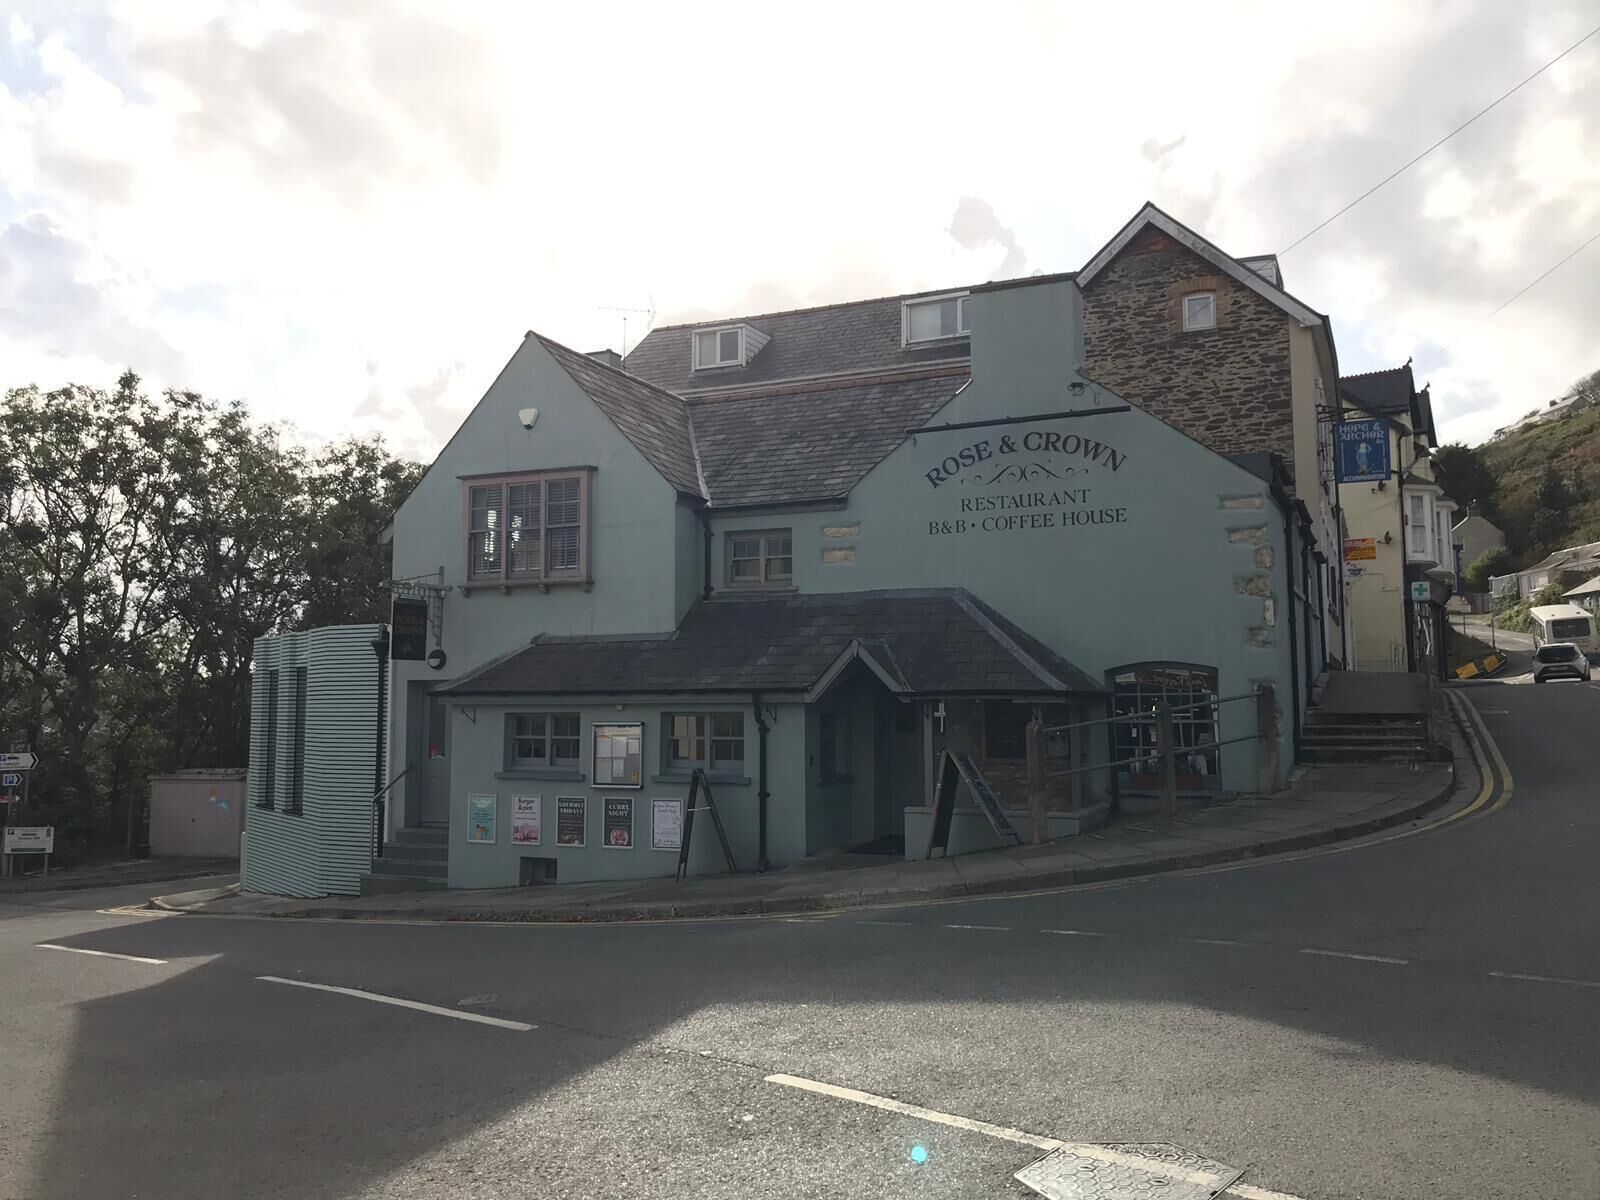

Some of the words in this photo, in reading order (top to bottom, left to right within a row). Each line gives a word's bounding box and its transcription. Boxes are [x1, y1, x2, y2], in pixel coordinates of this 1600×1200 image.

[1339, 423, 1369, 433] HOPE
[1373, 422, 1381, 431] &
[1340, 430, 1385, 441] ANCHOR
[924, 440, 993, 489] ROSE
[998, 435, 1018, 455] &
[1023, 431, 1128, 473] CROWN
[960, 488, 1092, 512] RESTAURANT
[982, 513, 1055, 532] COFFEE
[1062, 507, 1128, 527] HOUSE
